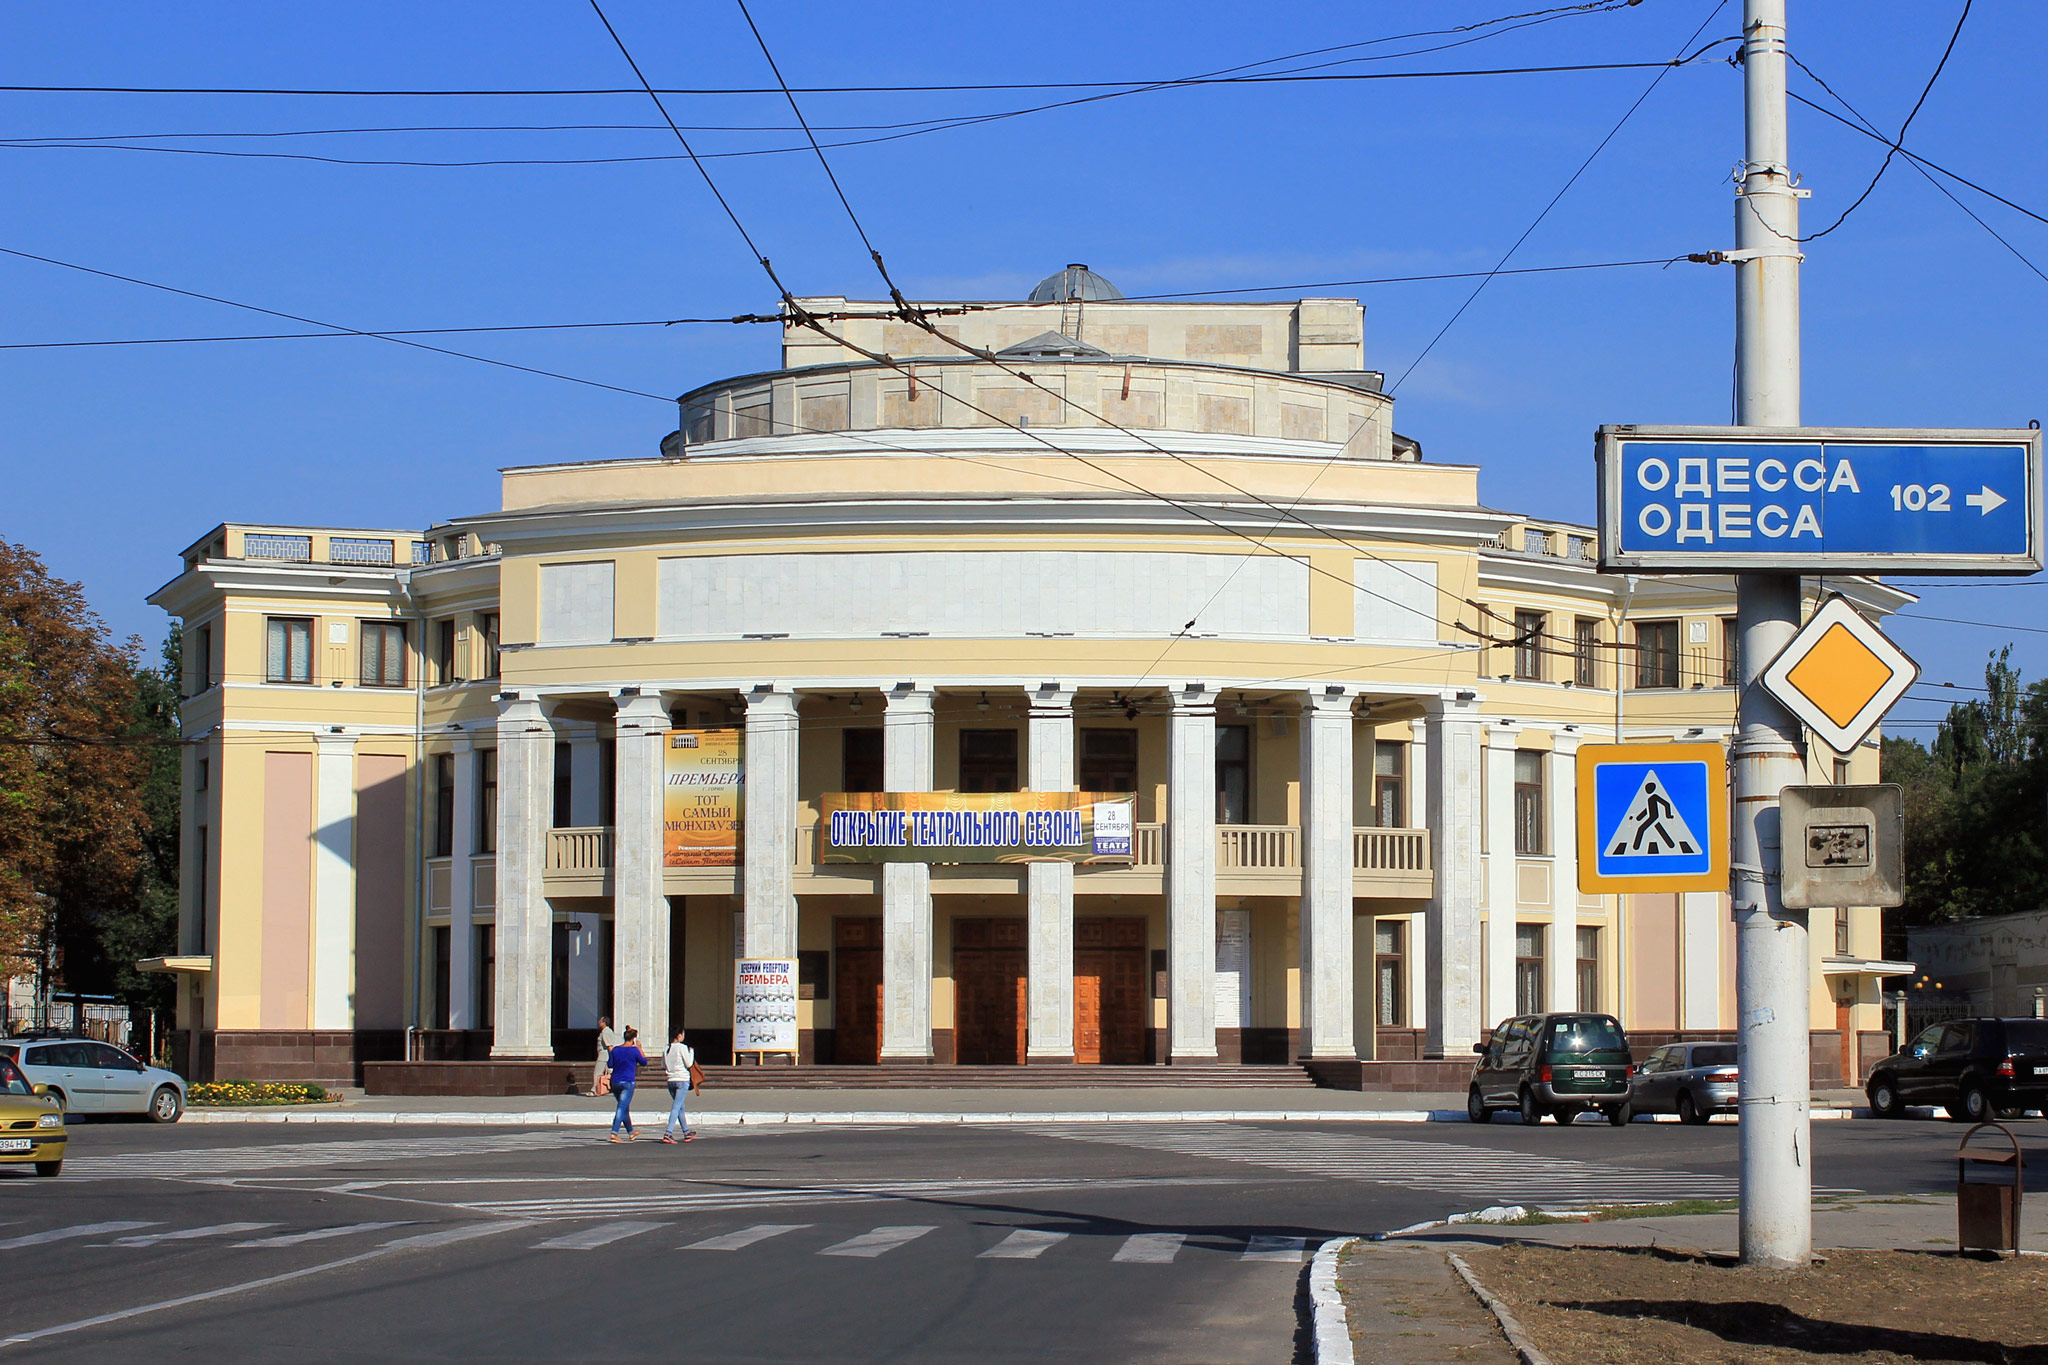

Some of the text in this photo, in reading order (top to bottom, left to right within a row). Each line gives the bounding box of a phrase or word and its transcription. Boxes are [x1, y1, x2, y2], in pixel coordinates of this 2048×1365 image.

[1637, 458, 1860, 498] ОДЕССА
[1890, 484, 1951, 512] 102
[1638, 503, 1823, 544] ОДЕСА
[700, 757, 743, 765] СЕНТЯБРЯ
[669, 773, 745, 784] ПРЕМЬЕРА
[695, 795, 719, 806] ТОТ
[683, 805, 730, 818] САМЫЙ
[1107, 810, 1116, 821] 28
[832, 810, 1082, 846] ОТКРЫТИЕ ТЕАТРАЛЬНОГО СЕЗОНА
[1095, 822, 1129, 831] СЕНТЯБРЯ
[739, 974, 789, 985] ПРЕМЬЕРА
